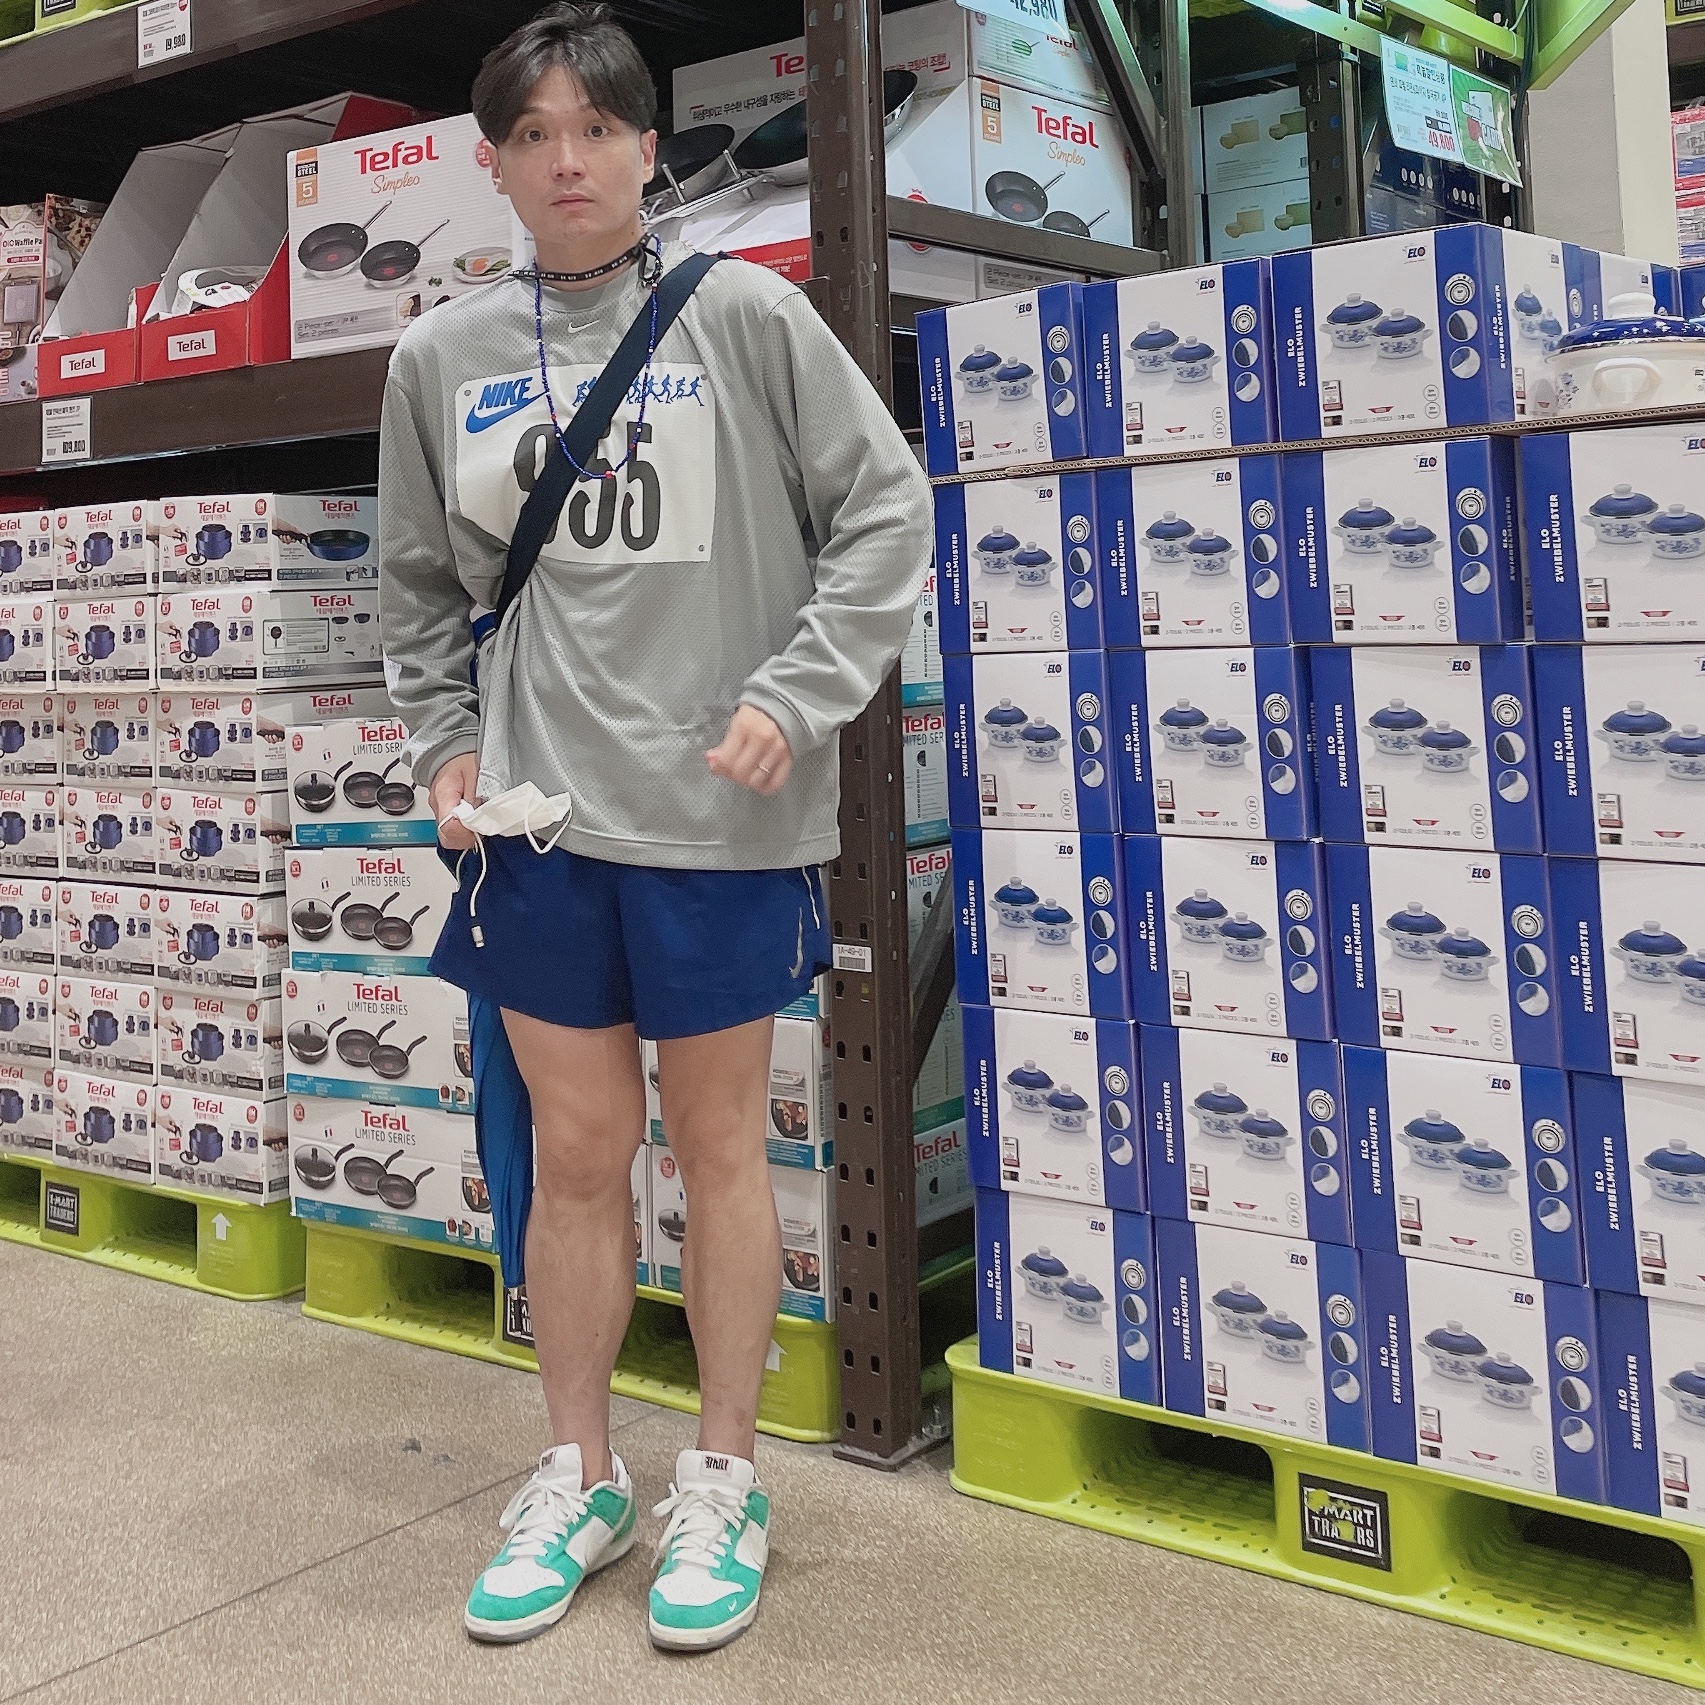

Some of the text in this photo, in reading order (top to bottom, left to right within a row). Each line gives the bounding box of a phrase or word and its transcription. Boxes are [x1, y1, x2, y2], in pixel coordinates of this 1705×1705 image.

[987, 117, 997, 133] 5
[1031, 106, 1099, 149] Tefal
[354, 134, 439, 175] Tefal
[302, 182, 312, 198] 5
[1407, 246, 1425, 258] ELO
[1200, 278, 1215, 290] ELO
[1019, 302, 1032, 313] ELO
[176, 338, 207, 354] Tefal
[1294, 307, 1305, 386] ZWIEBELMUSTER
[68, 356, 97, 371] Tefal
[1103, 333, 1112, 407] ZWIEBELMUSTER
[478, 376, 533, 410] NIKE
[1417, 456, 1437, 468] ELO
[1215, 470, 1232, 482] ELO
[1039, 489, 1052, 498] ELO
[197, 501, 231, 515] Tefal
[320, 499, 359, 513] Tefal
[0, 520, 22, 532] efal
[84, 511, 113, 524] Tefal
[1306, 507, 1317, 587] ZWIEBELMUSTER
[1541, 529, 1549, 548] ELO
[1549, 495, 1564, 582] ZWIEBELMUSTER
[1117, 520, 1127, 595] ZWIEBELMUSTER
[951, 534, 960, 605] ZWIEBELMUSTER
[87, 603, 116, 616] Tefal
[191, 598, 220, 611] Tefal
[311, 595, 353, 608] Tefal
[1048, 664, 1062, 673] ELO
[1230, 663, 1246, 672] ELO
[1452, 660, 1472, 671] ELO
[92, 698, 122, 712] Tefal
[188, 697, 221, 712] Tefal
[311, 694, 353, 708] Tefal
[358, 724, 405, 742] Tefal
[959, 704, 968, 776] ZWIEBELMUSTER
[353, 744, 382, 755] LIMITED
[1131, 704, 1142, 781] ZWIEBELMUSTER
[1335, 705, 1347, 787] ZWIEBELMUSTER
[1554, 741, 1562, 760] ELO
[1562, 707, 1577, 796] ZWIEBELMUSTER
[95, 791, 124, 805] Tefal
[191, 795, 223, 811] Tefal
[1059, 845, 1073, 854] ELO
[358, 857, 404, 874] Tefal
[905, 850, 951, 875] Tefal
[1250, 856, 1267, 865] ELO
[351, 876, 410, 887] LIMITED SERIES
[1472, 868, 1490, 878] ELO
[90, 890, 120, 905] Tefal
[189, 898, 220, 915] Tefal
[968, 880, 977, 954] ZWIEBELMUSTER
[1146, 892, 1157, 971] ZWIEBELMUSTER
[1351, 904, 1364, 988] ZWIEBELMUSTER
[1570, 955, 1579, 976] ELO
[1579, 922, 1593, 1012] ZWIEBELMUSTER
[89, 985, 119, 1002] Tefal
[354, 983, 400, 1002] Tefal
[191, 997, 226, 1014] Tefal
[348, 1001, 408, 1015] LIMITED SERIES
[1074, 1031, 1088, 1041] ELO
[1271, 1052, 1288, 1063] ELO
[87, 1080, 116, 1099] Tefal
[1491, 1078, 1510, 1090] ELO
[191, 1096, 224, 1116] Tefal
[980, 1060, 989, 1137] ZWIEBELMUSTER
[362, 1110, 409, 1132] Tefal
[1163, 1082, 1174, 1163] ZWIEBELMUSTER
[355, 1127, 415, 1145] LIMITED SERIES
[1368, 1108, 1381, 1194] ZWIEBELMUSTER
[1595, 1171, 1604, 1192] ELO
[1604, 1137, 1619, 1230] ZWIEBELMUSTER
[1090, 1221, 1105, 1231] ELO
[1291, 1254, 1307, 1265] ELO
[994, 1242, 1002, 1320] ZWIEBELMUSTER
[1514, 1293, 1533, 1305] ELO
[1179, 1277, 1191, 1360] ZWIEBELMUSTER
[1380, 1347, 1388, 1367] ELO
[1388, 1315, 1401, 1403] ZWIEBELMUSTER
[1618, 1389, 1627, 1411] ELO
[1627, 1355, 1642, 1450] ZWIEBELMUSTER
[1312, 1516, 1375, 1548] TRARS
